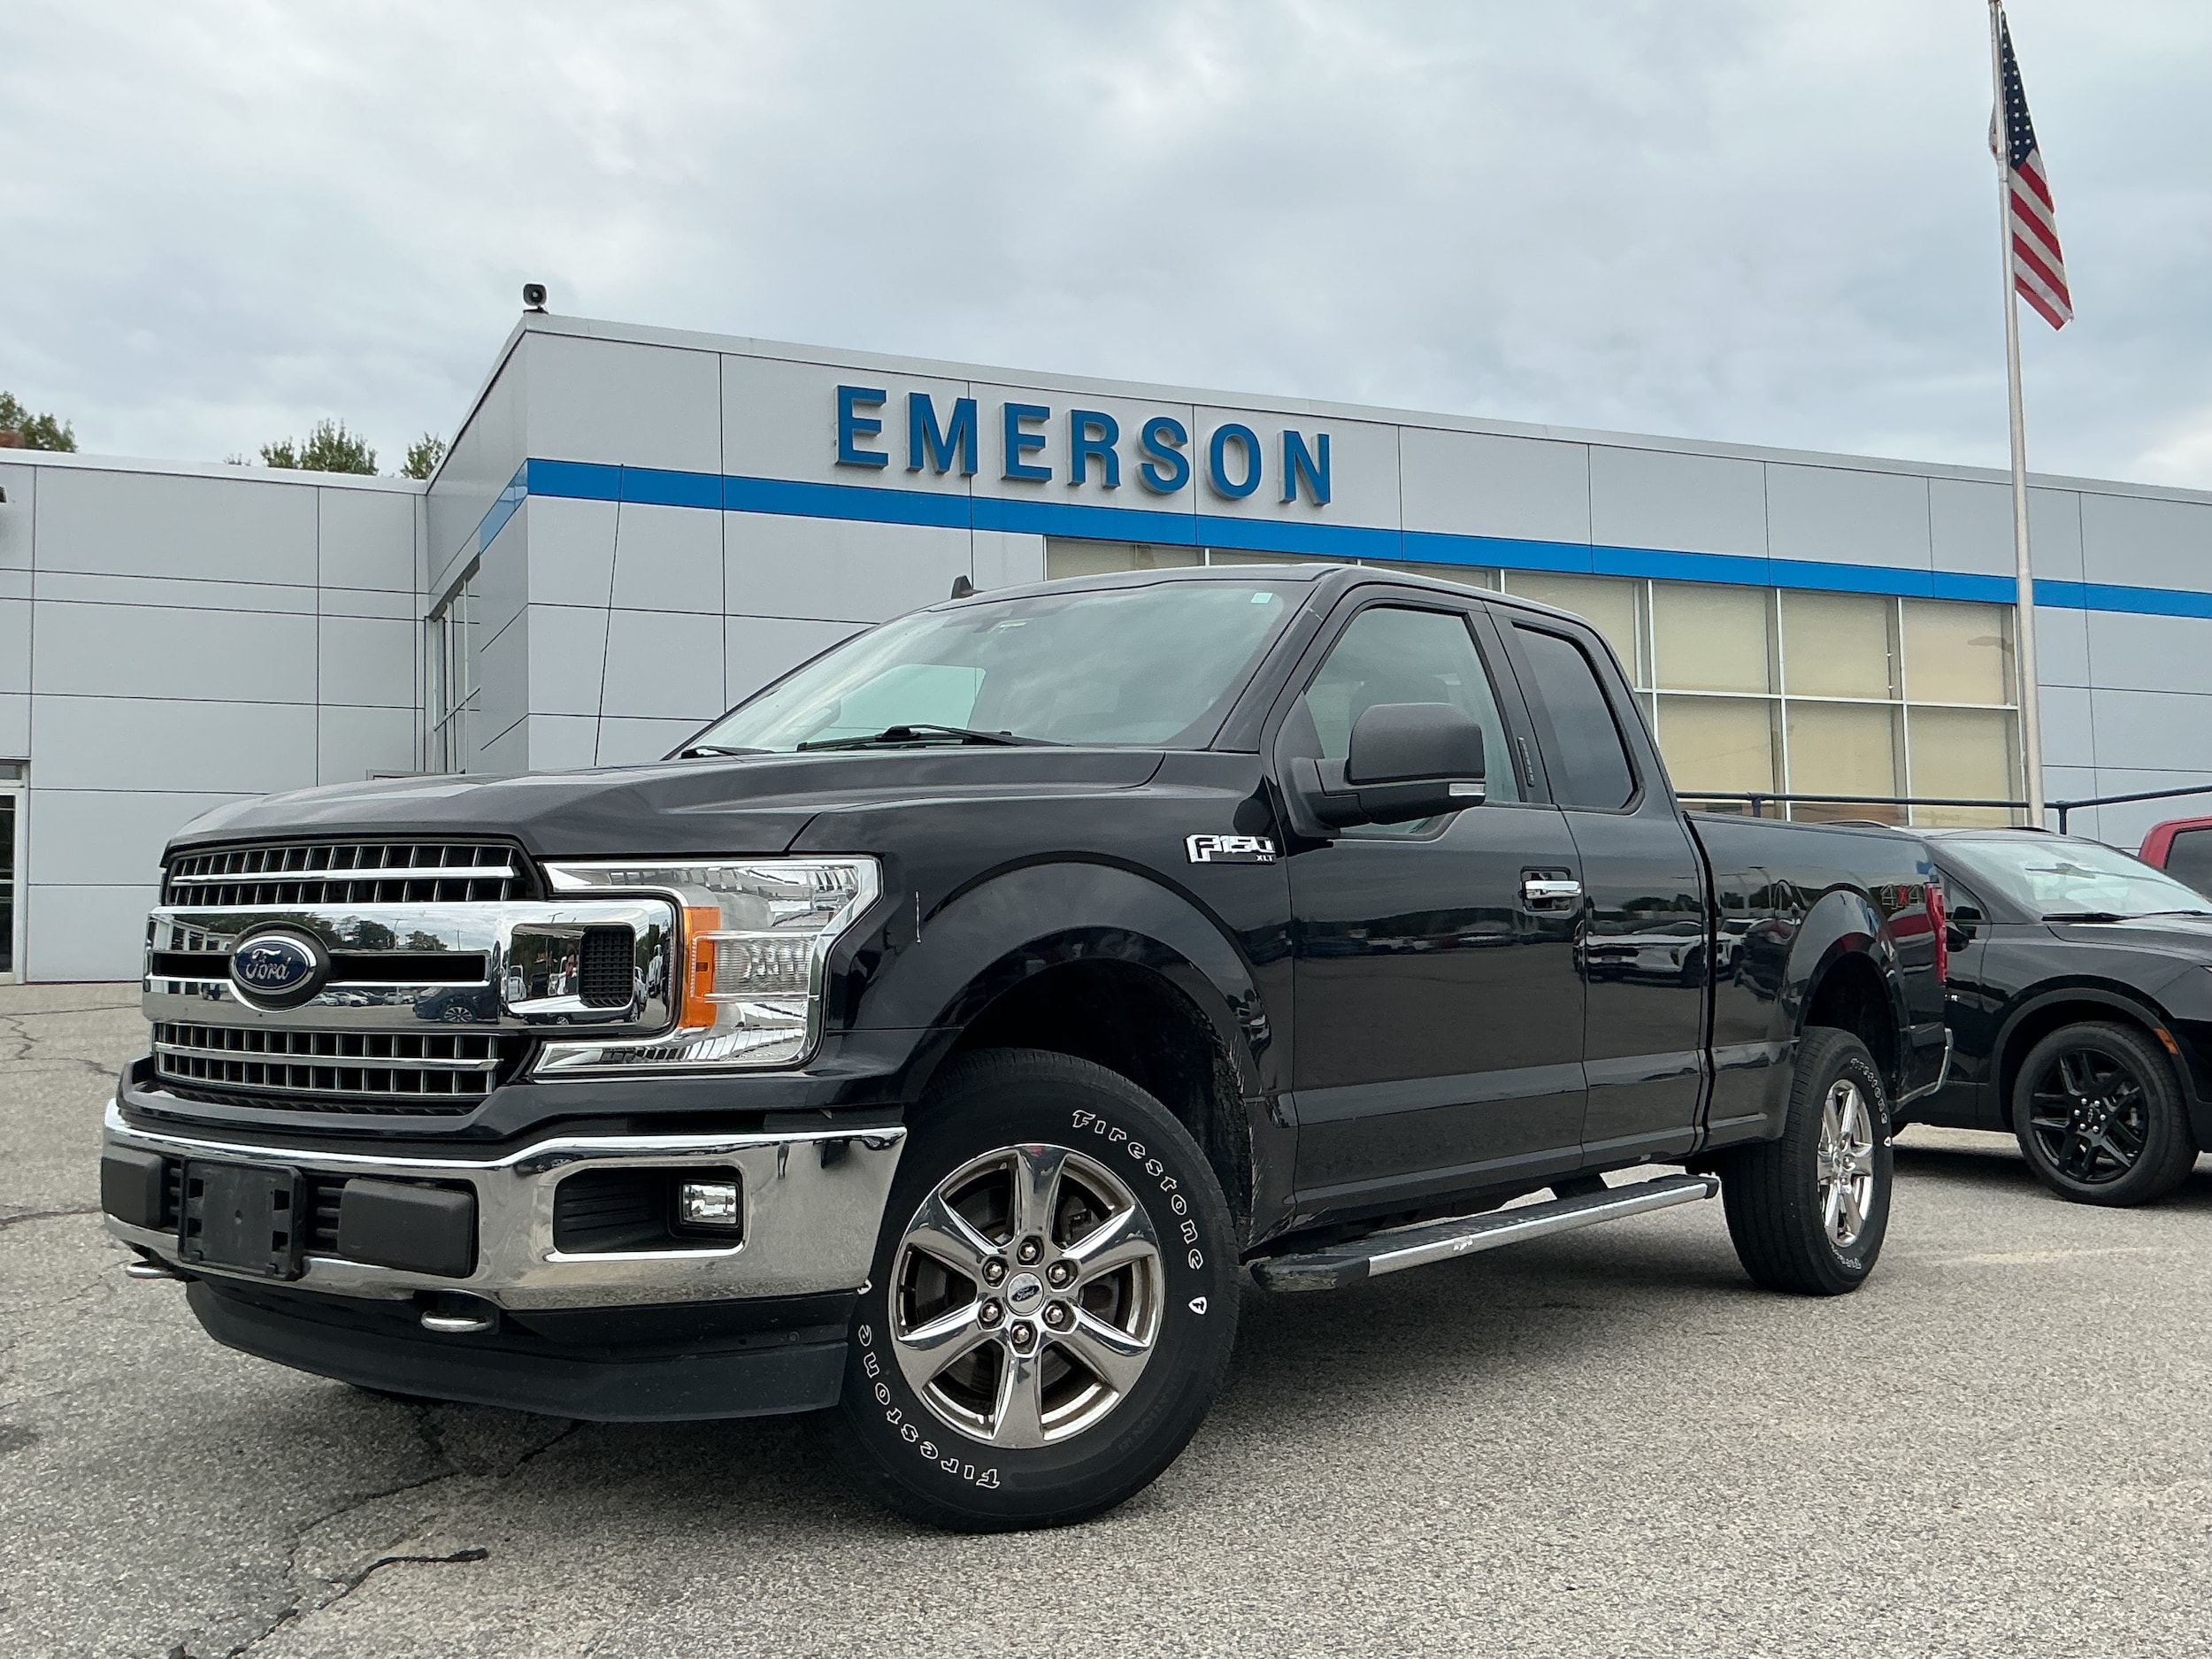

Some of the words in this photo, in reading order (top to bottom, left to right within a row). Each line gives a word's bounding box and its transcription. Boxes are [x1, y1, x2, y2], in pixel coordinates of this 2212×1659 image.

[834, 384, 1331, 505] EMERSON
[245, 948, 292, 980] Ford
[1071, 1110, 1203, 1271] Firestone
[857, 1324, 1002, 1489] Firestone
